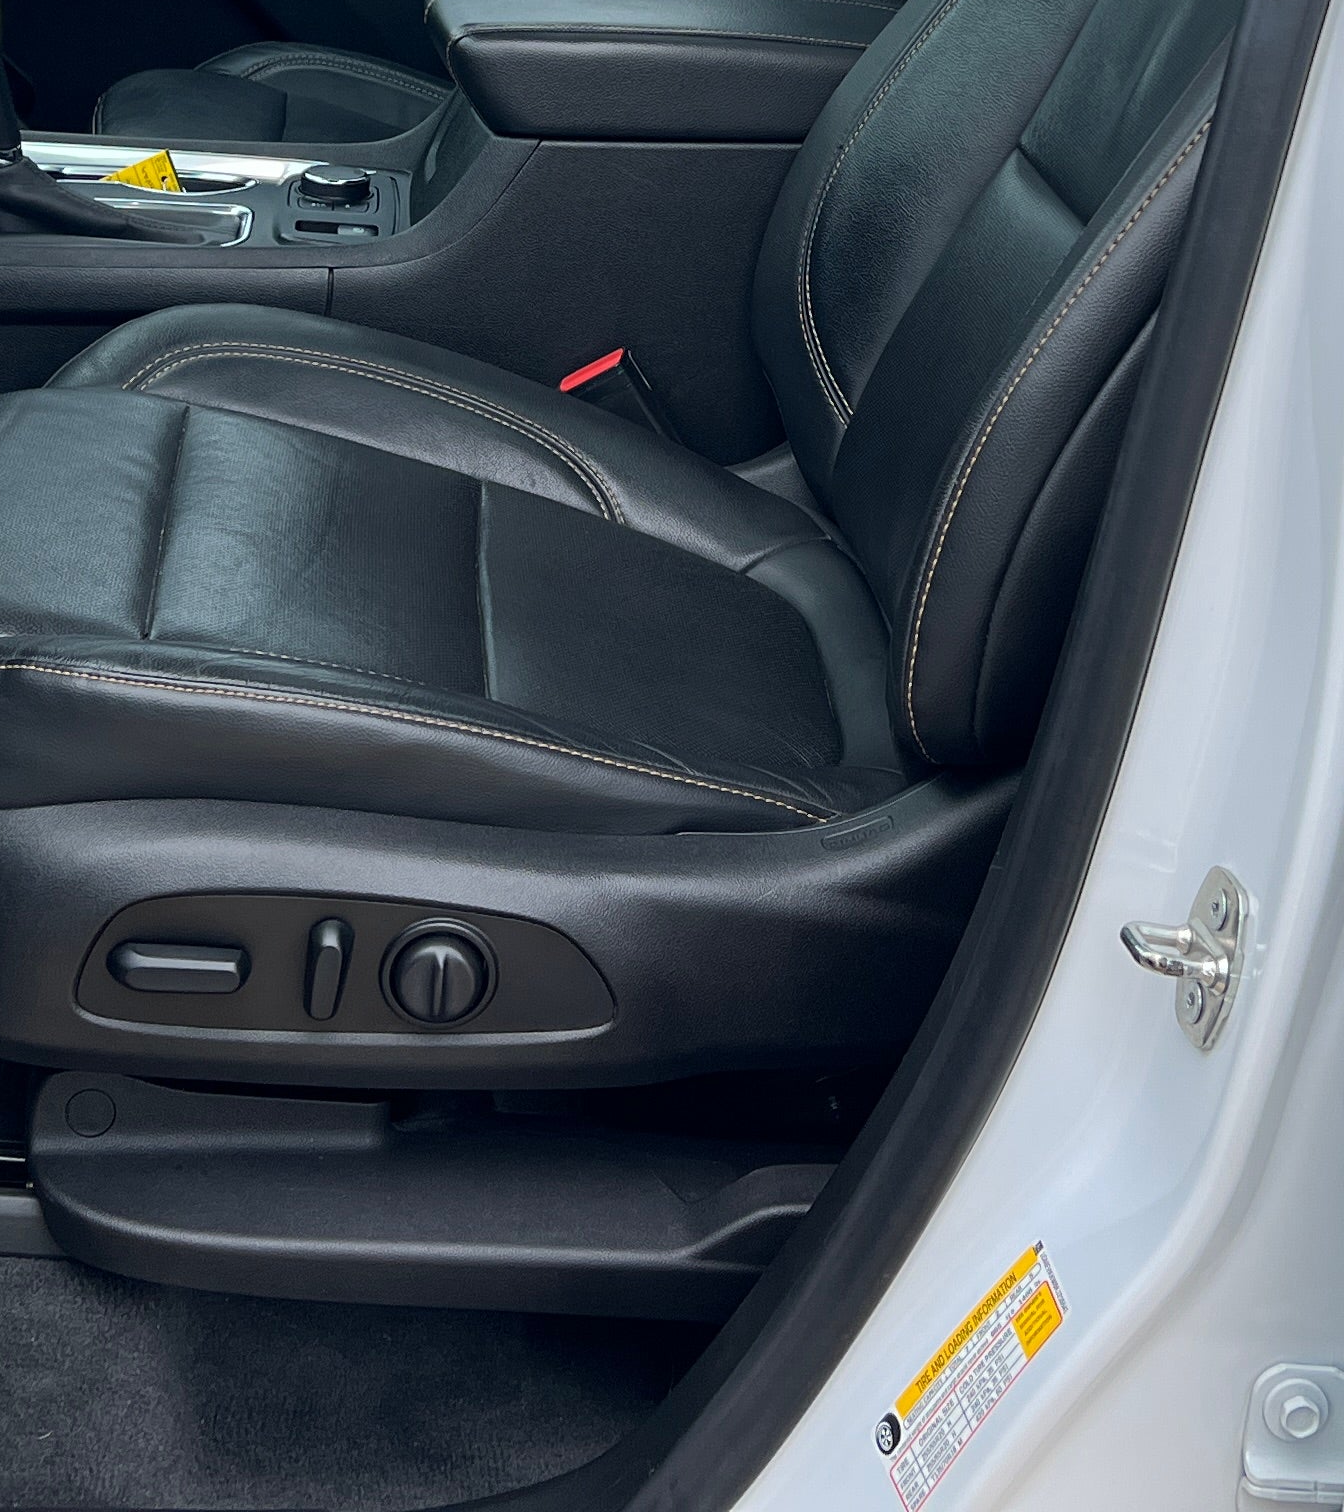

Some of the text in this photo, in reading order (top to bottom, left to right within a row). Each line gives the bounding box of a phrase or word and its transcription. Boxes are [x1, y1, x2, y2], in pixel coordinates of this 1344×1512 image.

[915, 1269, 1017, 1394] TIRE AND LOADING INFORMATION
[917, 1413, 942, 1447] ORIGINAL
[941, 1397, 954, 1416] SIZE
[958, 1373, 973, 1395] COLD
[973, 1359, 985, 1377] TIRE
[984, 1326, 1011, 1363] PRESSURE
